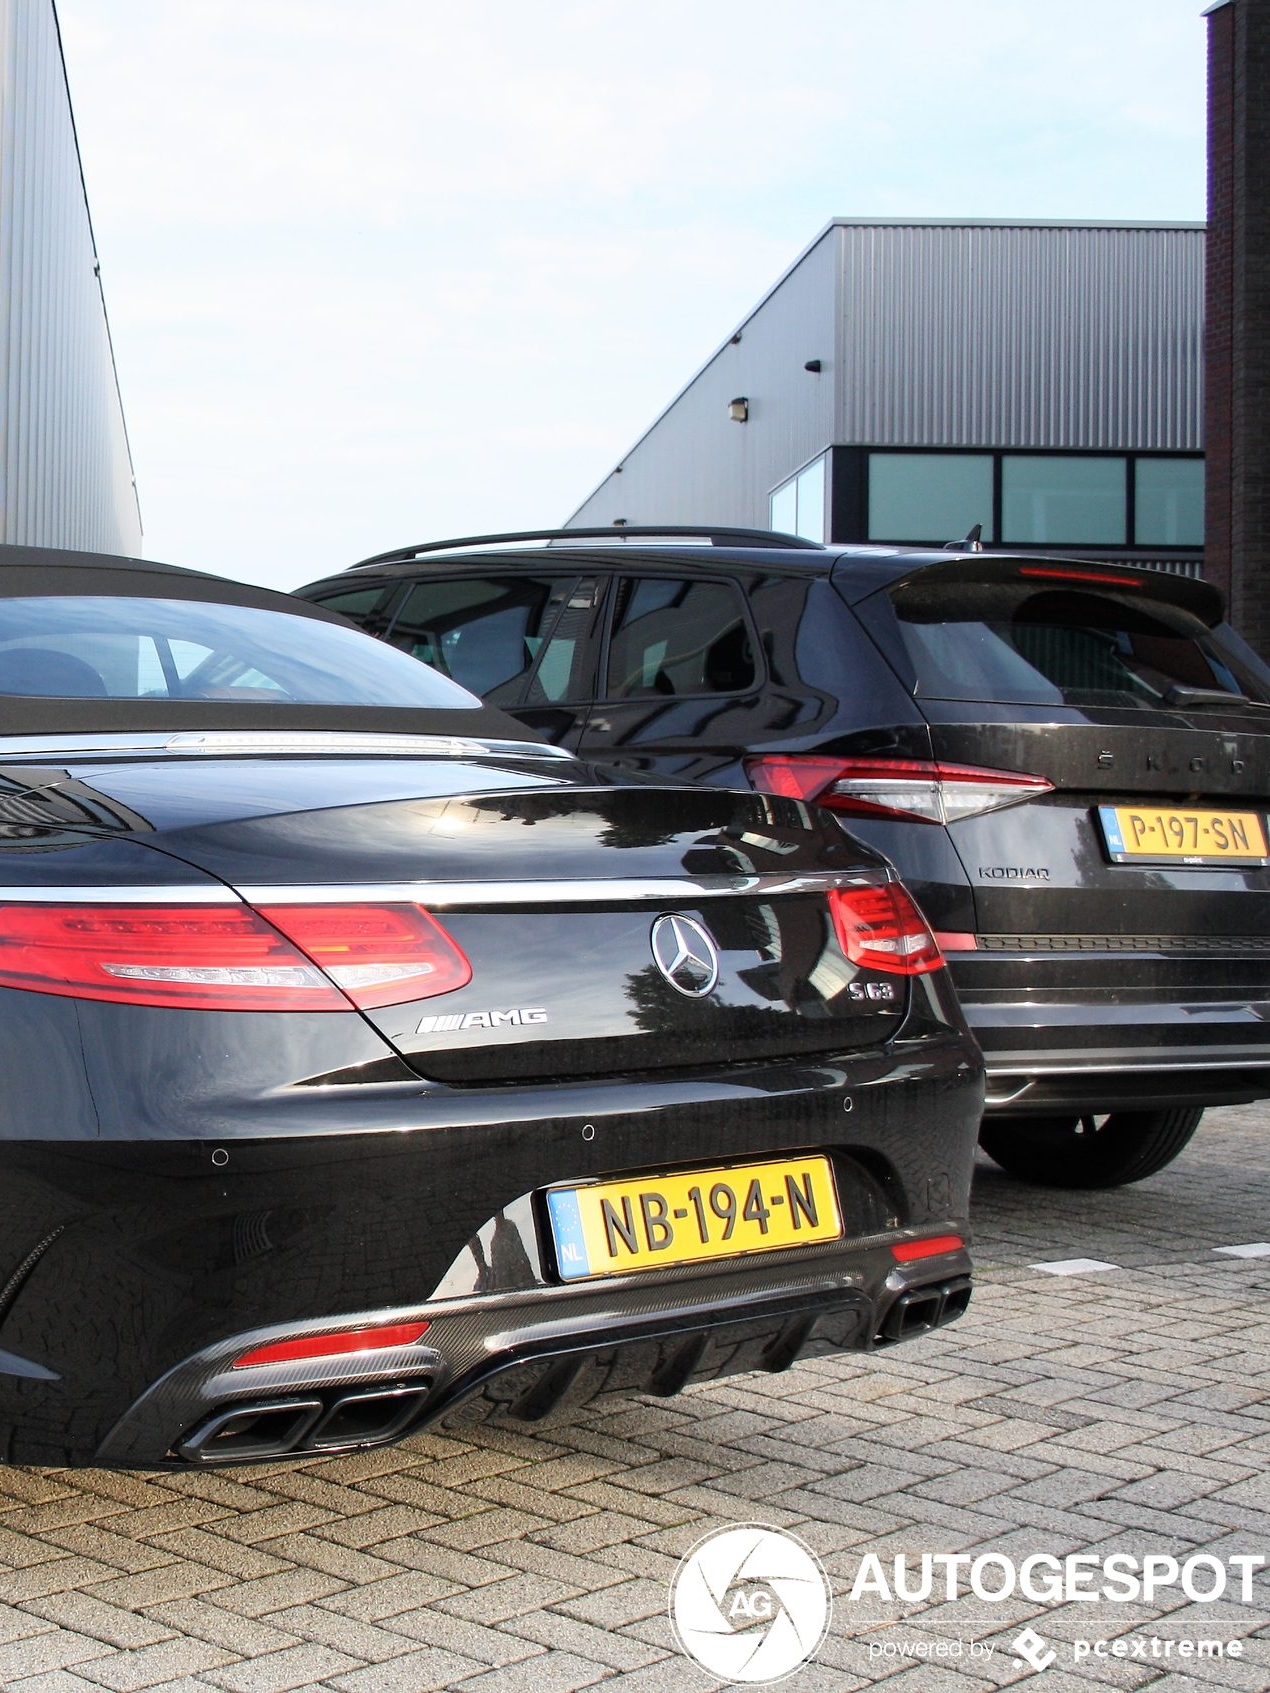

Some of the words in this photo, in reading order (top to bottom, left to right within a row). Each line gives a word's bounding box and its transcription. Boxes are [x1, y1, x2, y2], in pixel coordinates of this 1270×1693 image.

[1109, 835, 1122, 845] NL
[1130, 815, 1250, 850] P-197-SN
[978, 867, 1051, 881] KODIAQ
[601, 1172, 819, 1257] NB-194-N
[562, 1243, 583, 1262] NL
